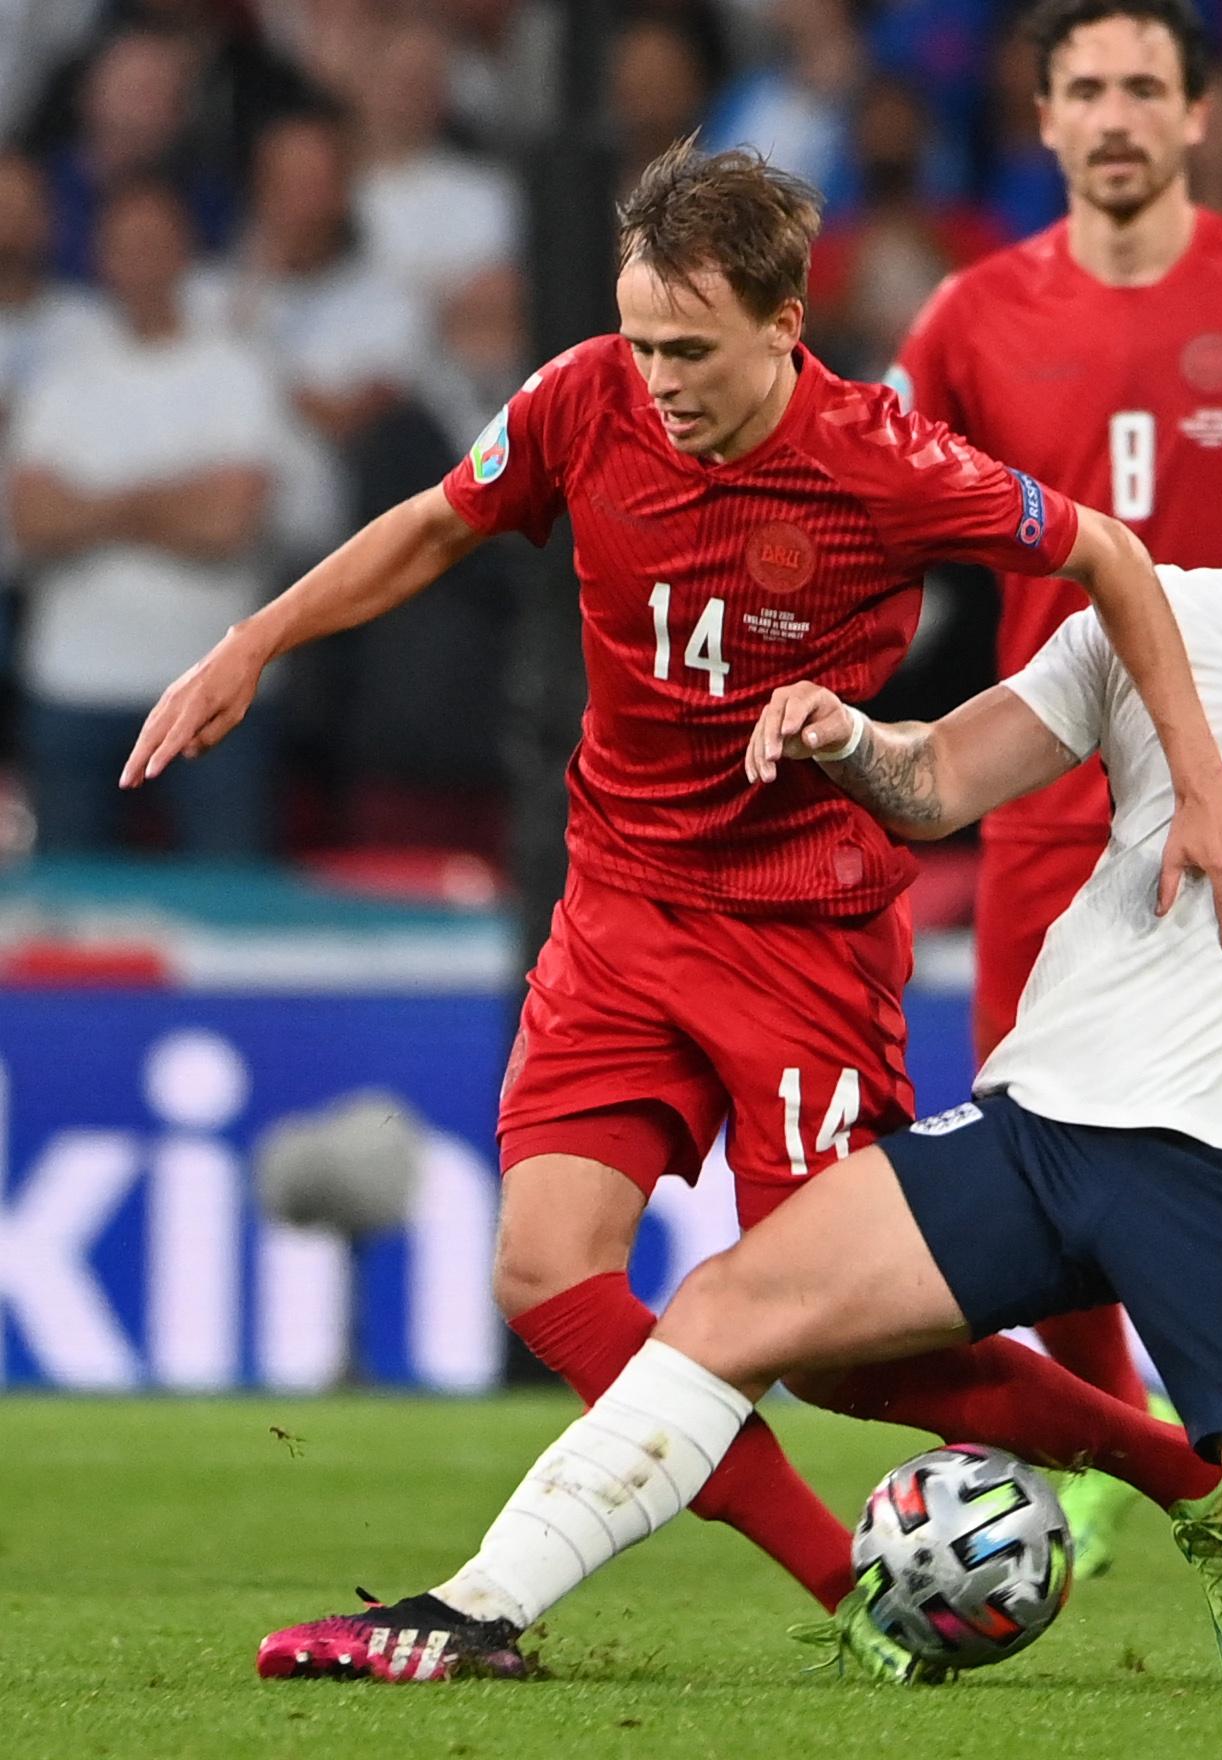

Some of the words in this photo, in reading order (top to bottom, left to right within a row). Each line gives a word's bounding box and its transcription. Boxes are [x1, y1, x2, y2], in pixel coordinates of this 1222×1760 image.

[1109, 410, 1156, 521] 8
[647, 582, 730, 698] 14
[778, 1068, 860, 1175] 14
